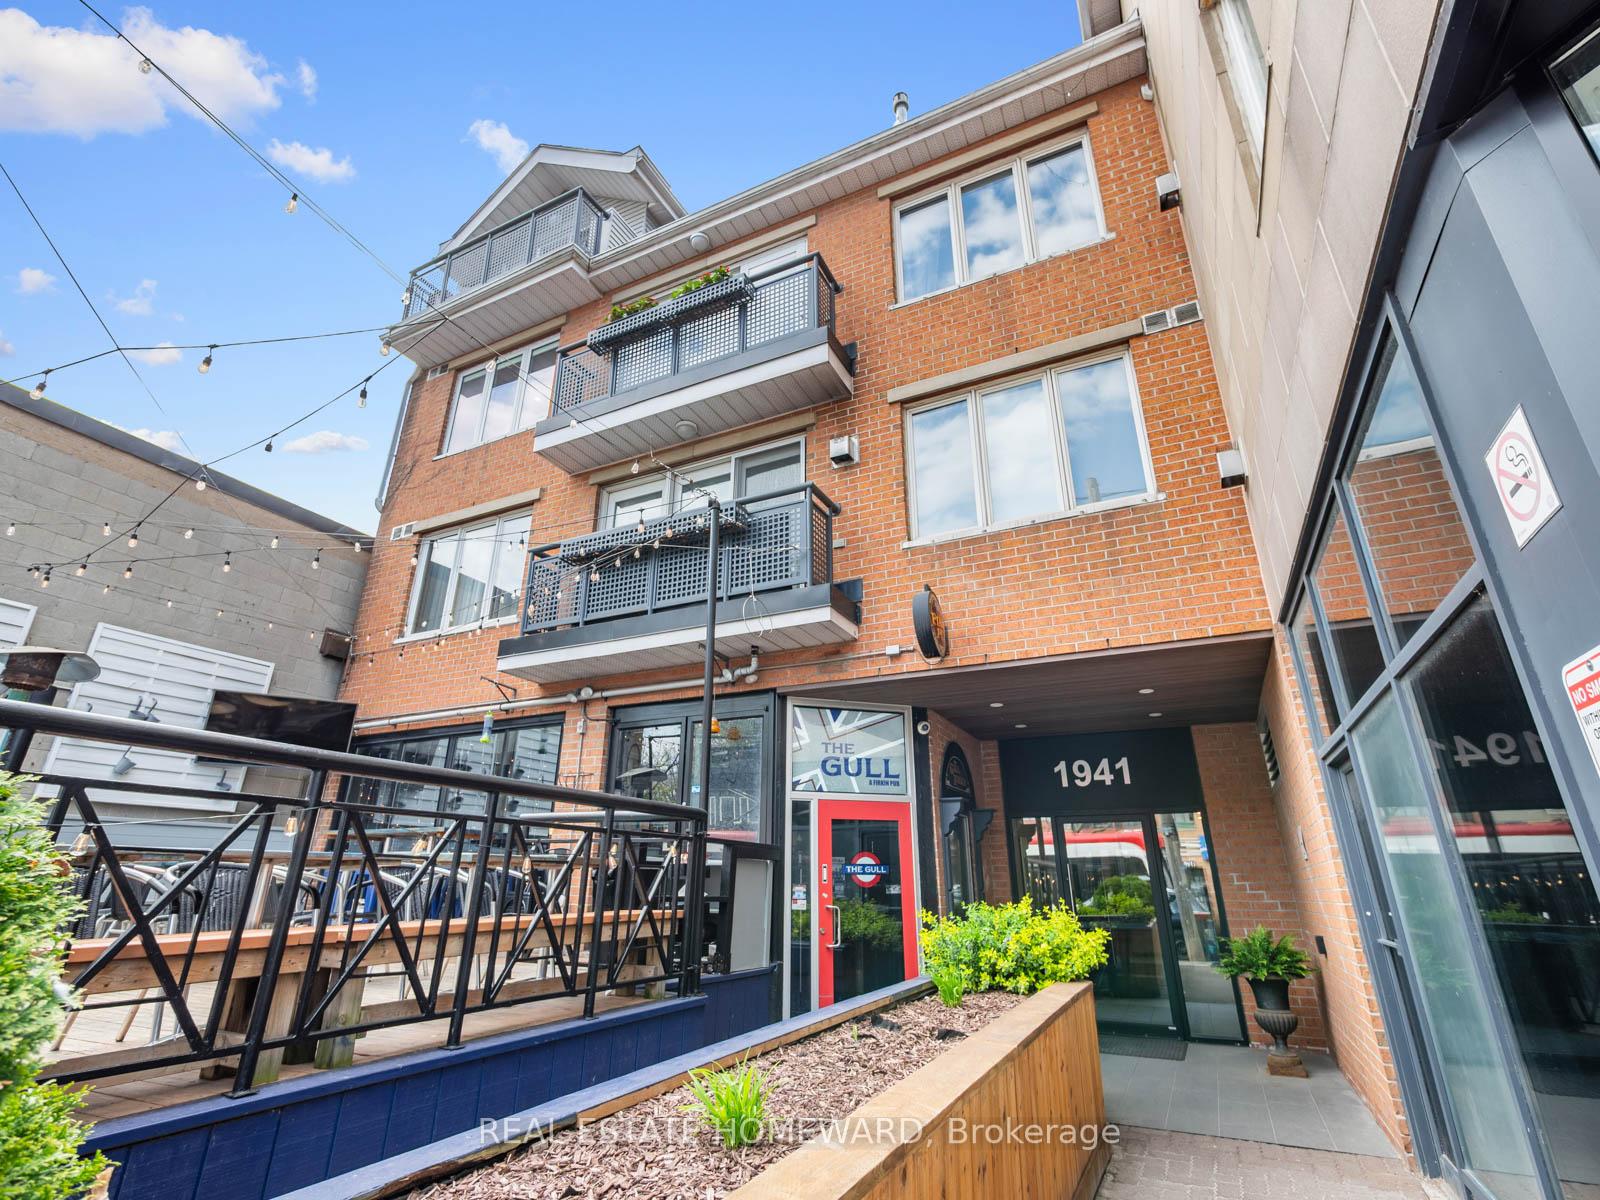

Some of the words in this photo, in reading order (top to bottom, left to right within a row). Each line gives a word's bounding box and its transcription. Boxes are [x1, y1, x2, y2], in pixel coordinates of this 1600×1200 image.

[1572, 688, 1587, 705] NO
[1586, 677, 1600, 698] SM
[821, 742, 855, 754] THE
[820, 756, 900, 779] GULL
[1053, 756, 1131, 788] 1941
[846, 865, 863, 873] THE
[864, 865, 886, 873] GULL
